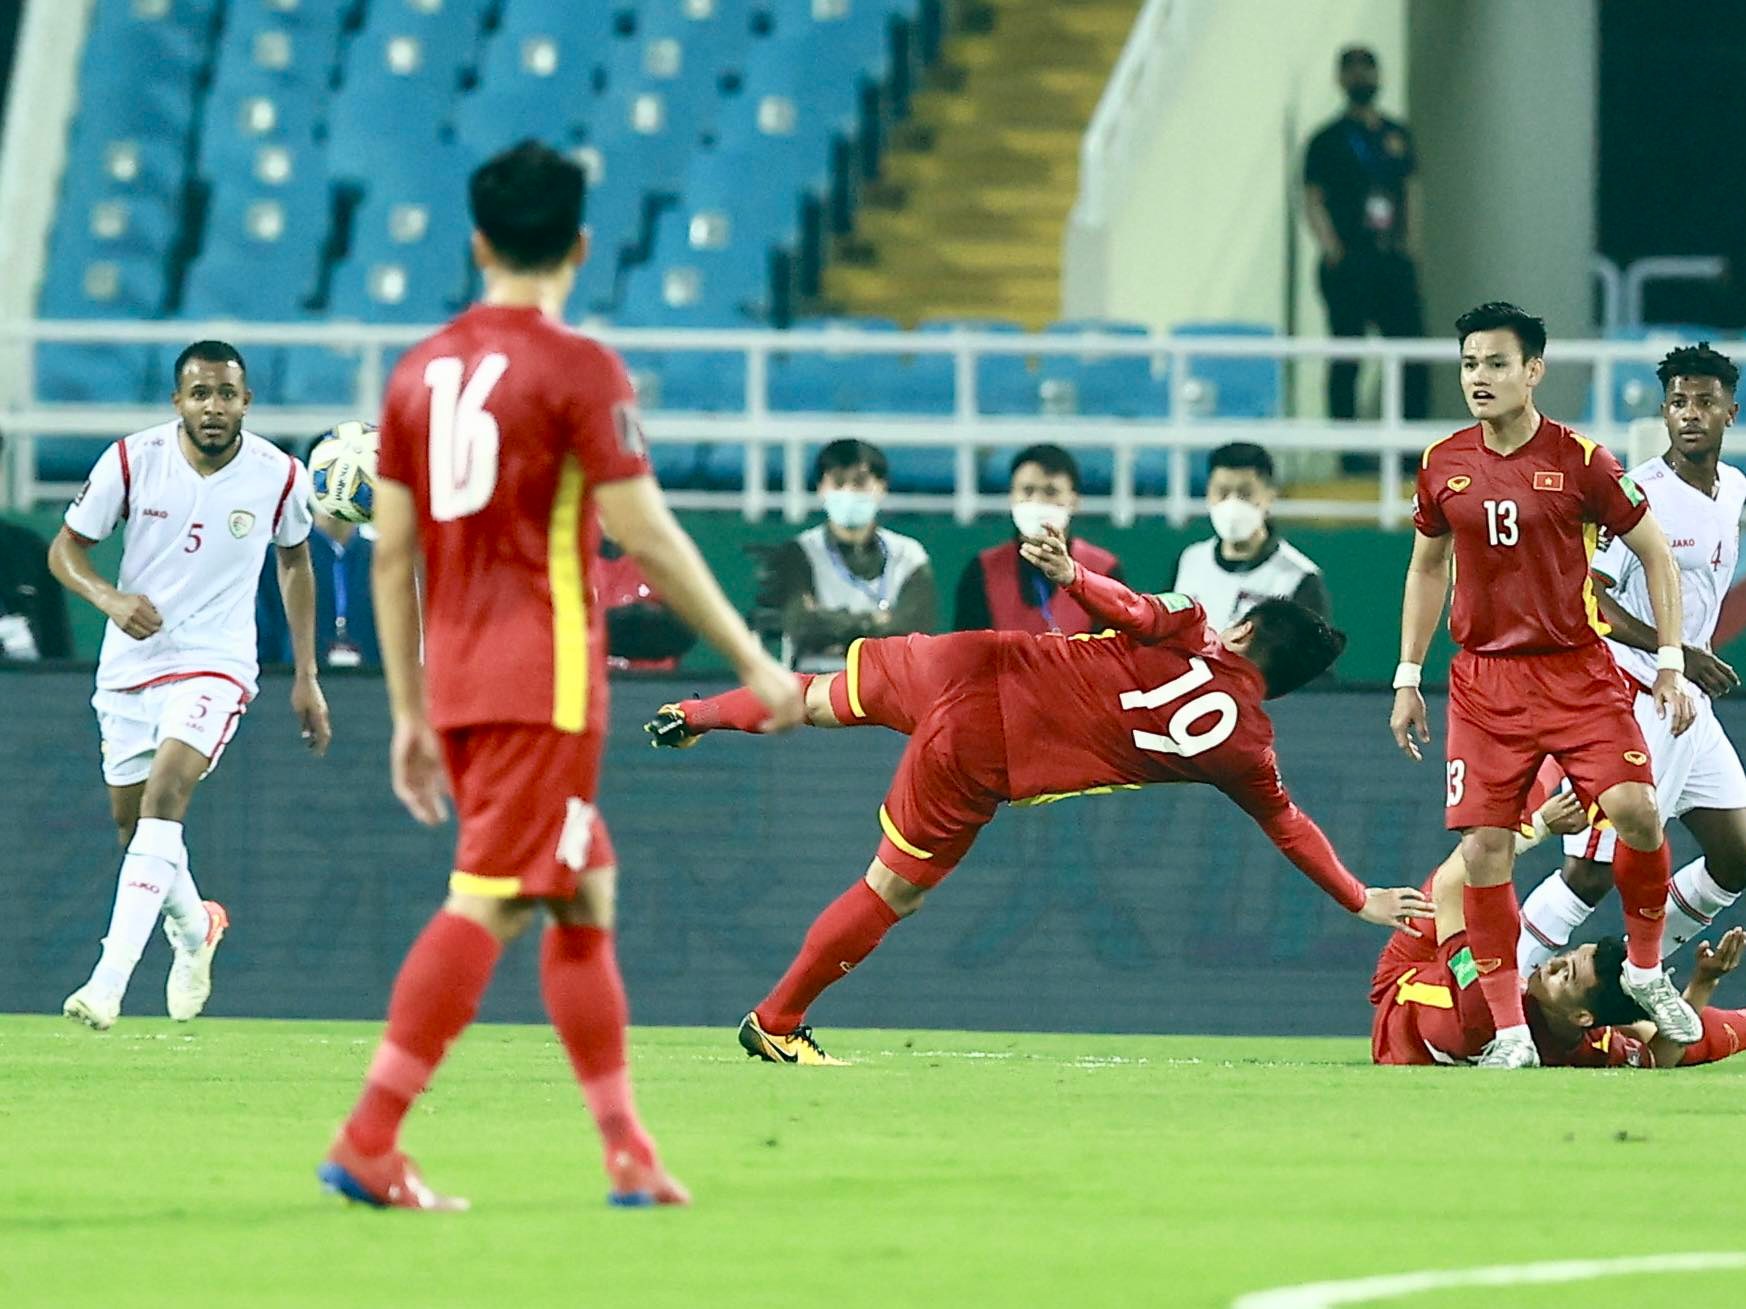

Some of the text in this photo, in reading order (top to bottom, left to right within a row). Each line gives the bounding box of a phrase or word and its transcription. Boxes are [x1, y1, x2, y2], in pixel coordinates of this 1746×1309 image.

[424, 352, 509, 521] 16
[184, 523, 204, 553] 5
[1483, 500, 1519, 546] 13
[1672, 539, 1695, 548] JAKO
[1711, 540, 1722, 572] 4
[190, 695, 212, 719] 5
[1120, 656, 1238, 758] 19
